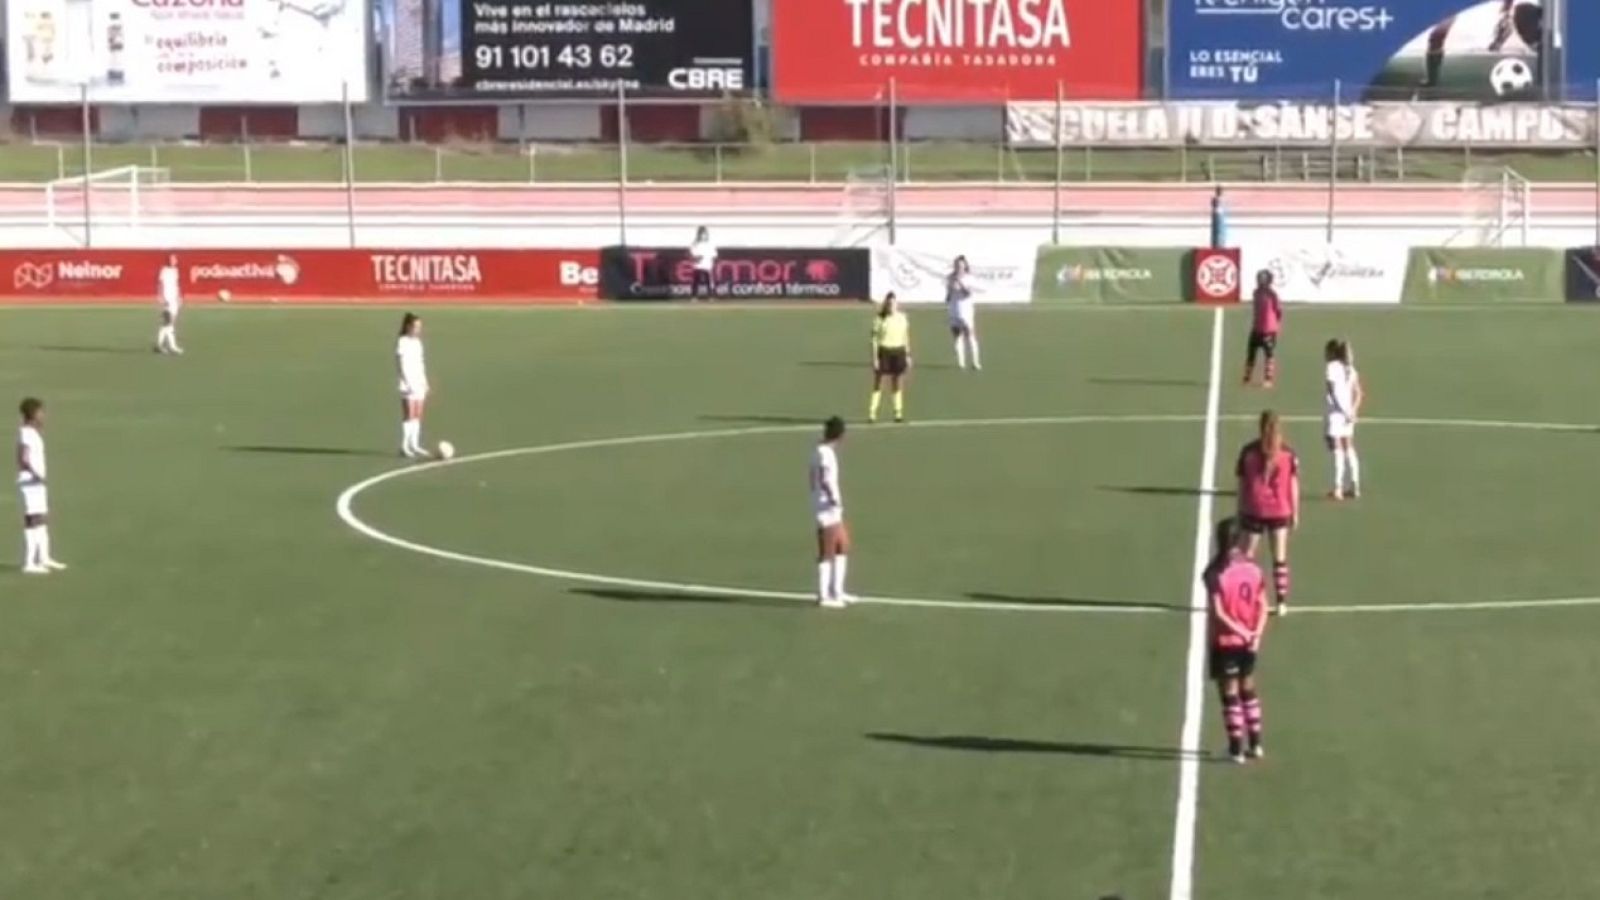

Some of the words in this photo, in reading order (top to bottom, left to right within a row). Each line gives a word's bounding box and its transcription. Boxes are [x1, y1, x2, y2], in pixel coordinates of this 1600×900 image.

[474, 1, 508, 17] Vive
[512, 5, 532, 17] en
[536, 2, 551, 17] el
[554, 1, 646, 17] rascacielos
[1281, 7, 1394, 30] cares+
[474, 18, 508, 33] más
[511, 18, 590, 33] innovador
[594, 18, 614, 33] de
[618, 18, 675, 33] Madrid
[843, 0, 1071, 48] TECNITASA
[475, 45, 502, 67] 91
[510, 45, 549, 67] 101
[557, 45, 592, 67] 43
[600, 44, 634, 67] 62
[963, 53, 1056, 66] TASADORA
[1189, 50, 1211, 63] LO
[1214, 49, 1284, 64] ESENCIAL
[668, 68, 744, 90] CBRE
[1190, 65, 1225, 78] ERES
[1229, 59, 1259, 83] TÚ
[1255, 104, 1374, 140] SANSE
[371, 254, 482, 283] TECNITASA
[1239, 581, 1252, 605] 9
